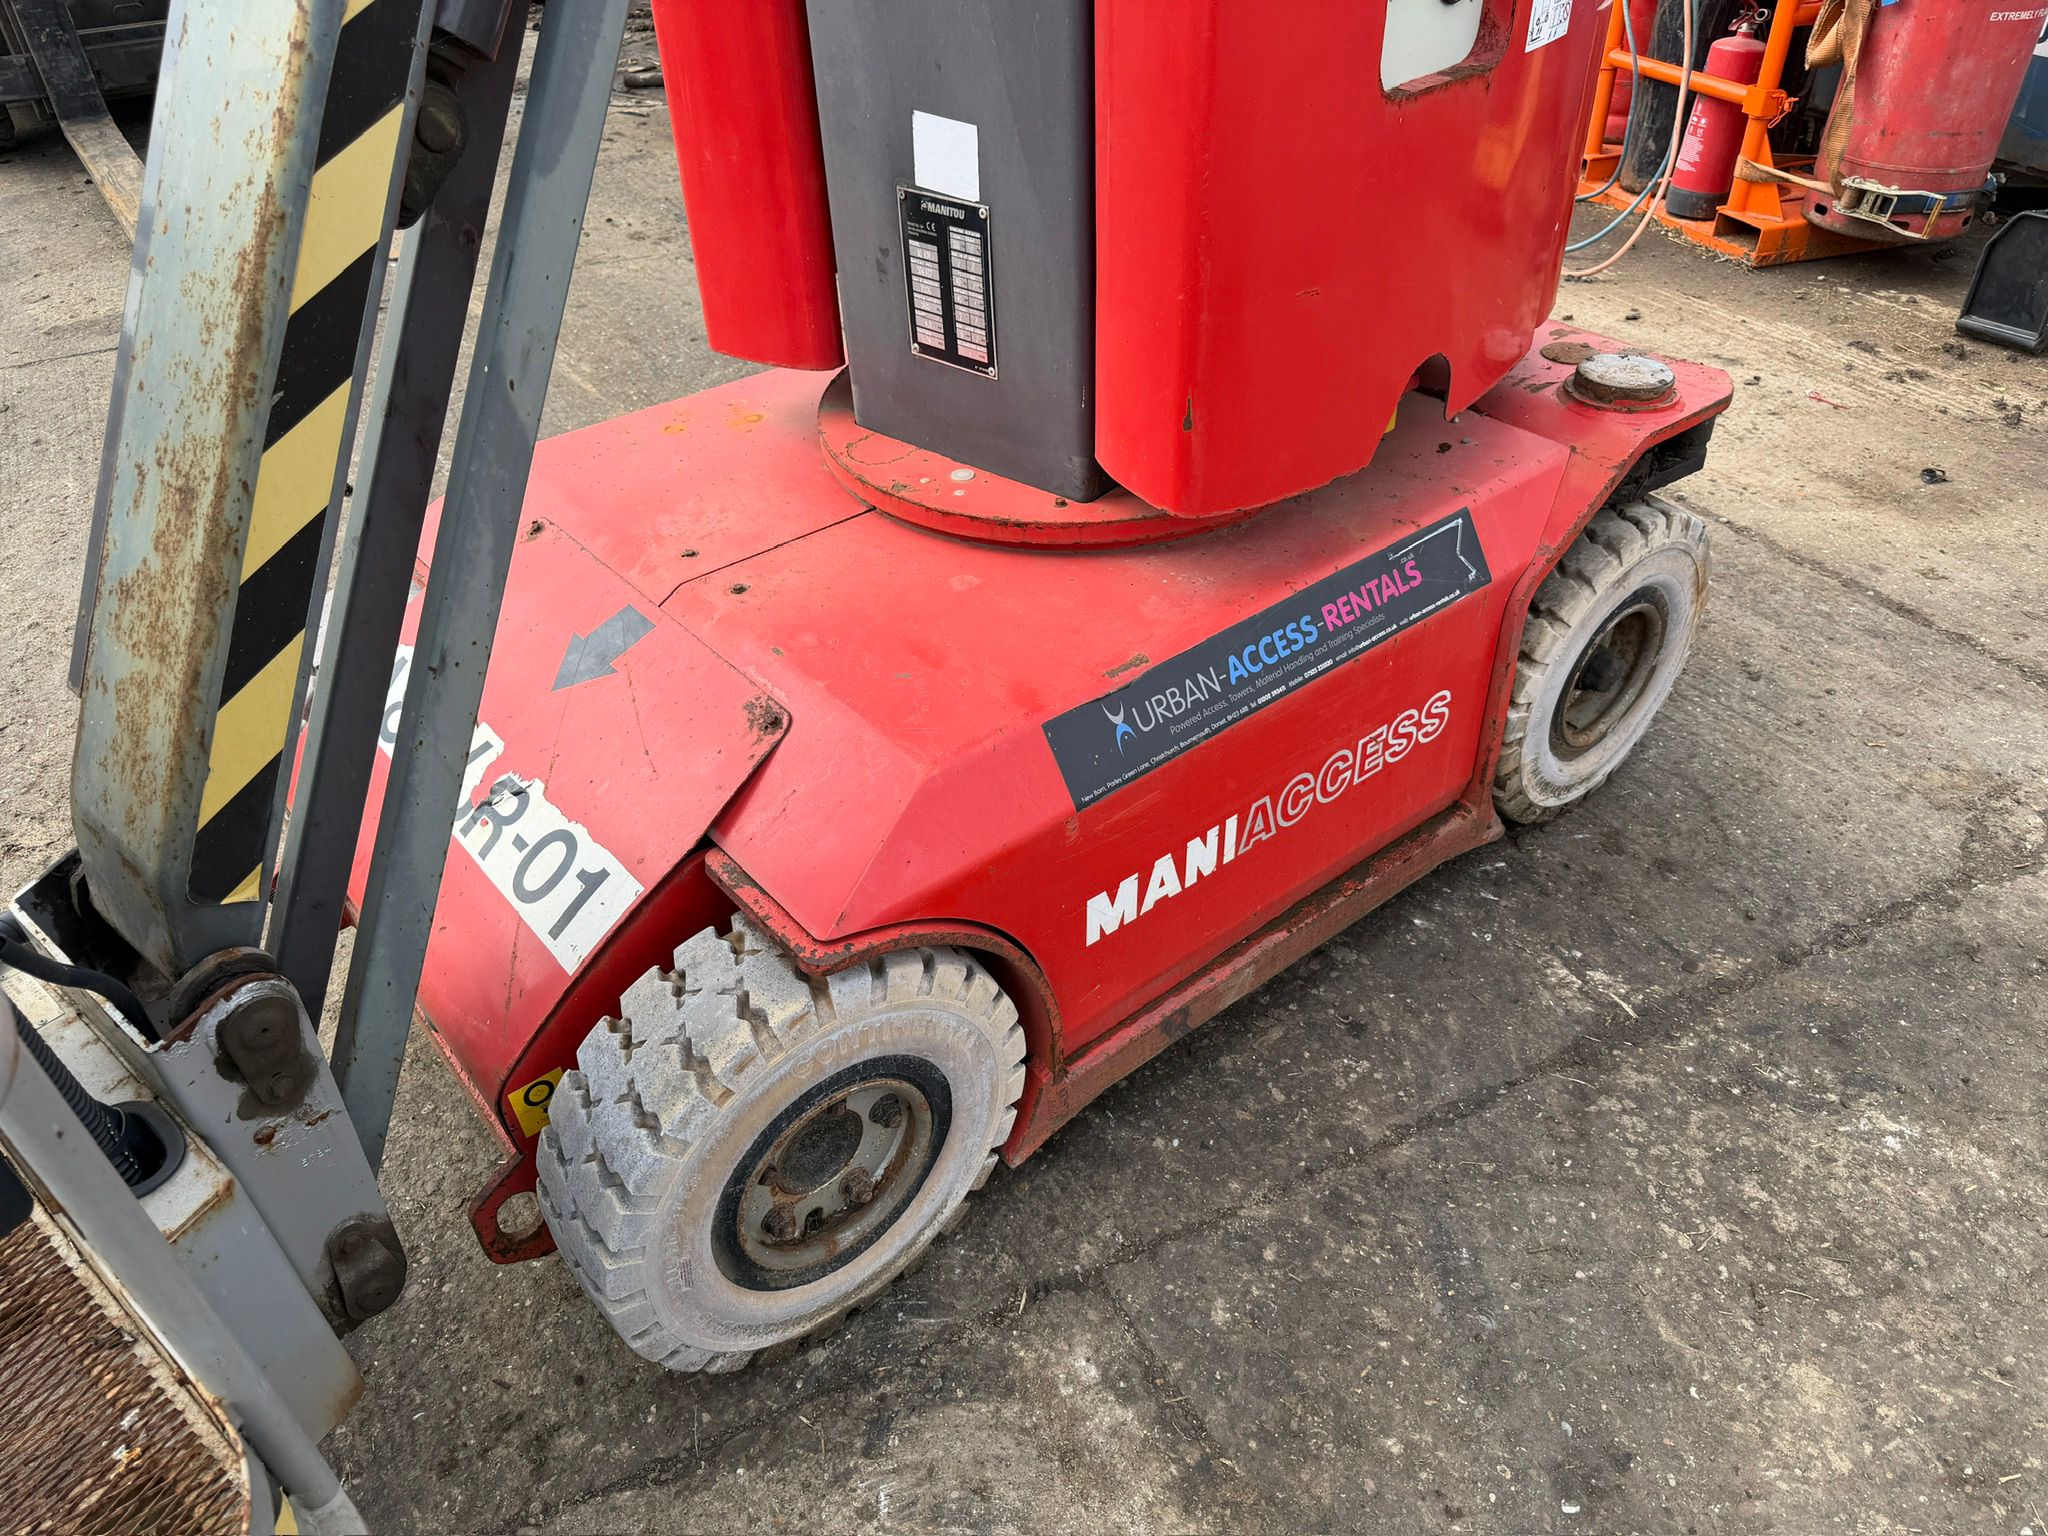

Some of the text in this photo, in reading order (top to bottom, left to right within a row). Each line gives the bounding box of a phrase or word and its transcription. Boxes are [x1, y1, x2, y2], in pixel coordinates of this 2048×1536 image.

[1990, 10, 2037, 21] EXTREMELY
[928, 202, 965, 220] MANITOU
[1170, 614, 1385, 735] Powered Access, Towers, Material Handling and Training Specialists
[1081, 794, 1093, 802] New
[1122, 769, 1137, 779] Green
[1086, 690, 1451, 947] MANIACCESS
